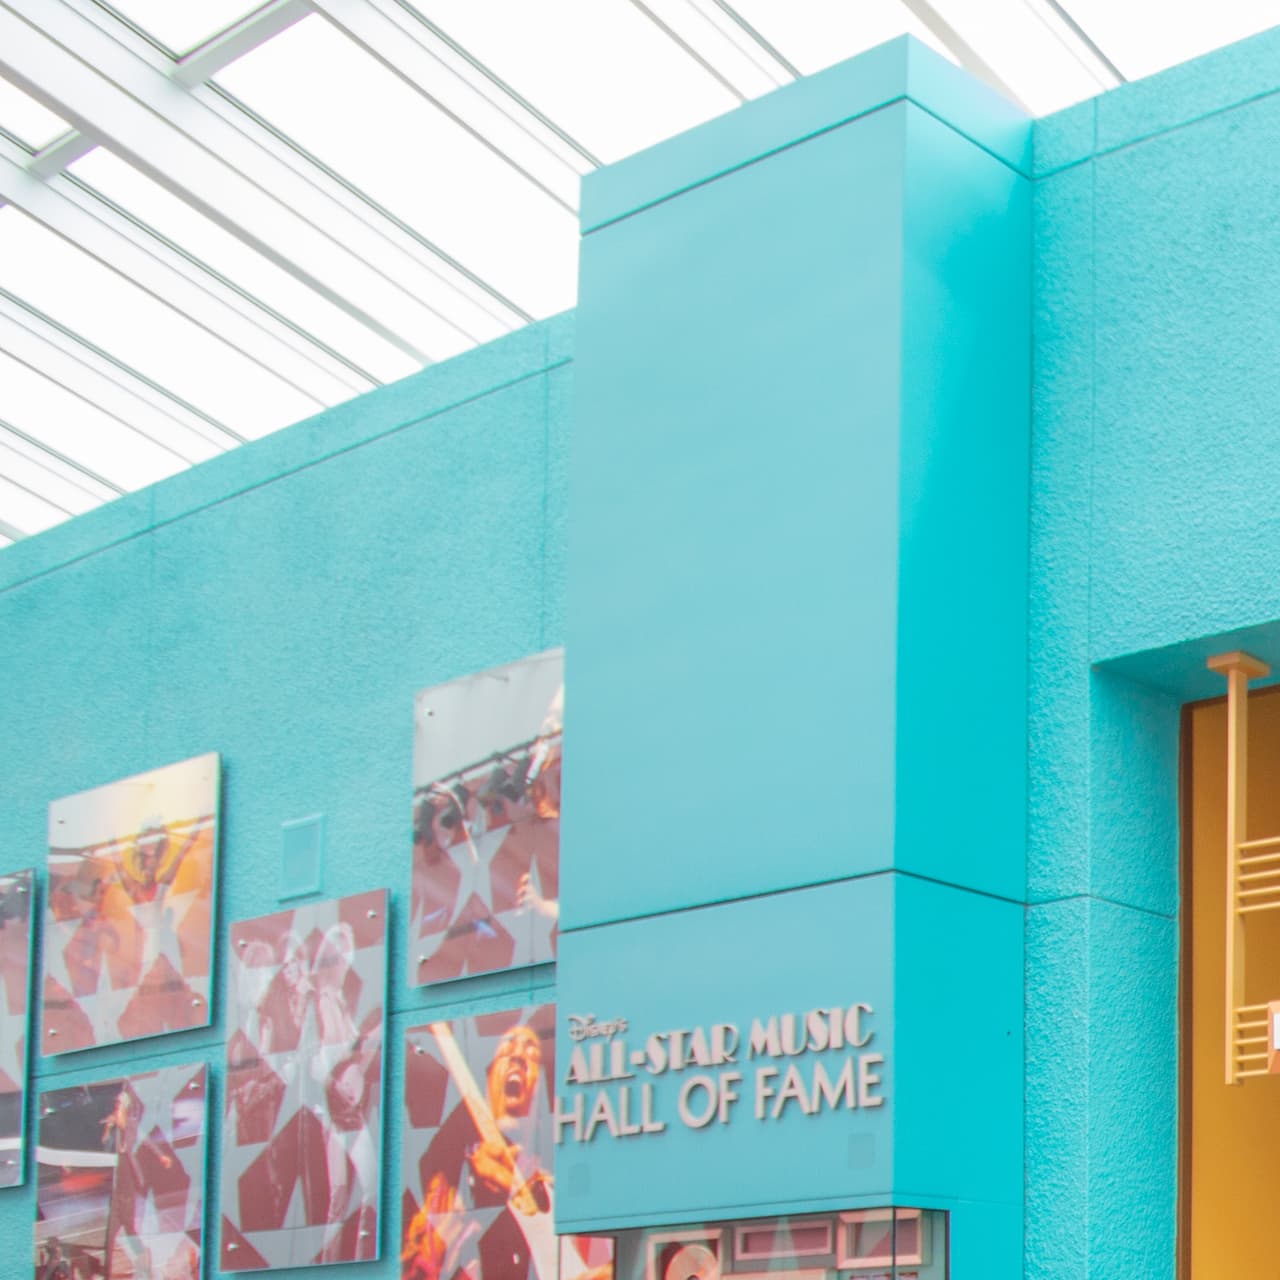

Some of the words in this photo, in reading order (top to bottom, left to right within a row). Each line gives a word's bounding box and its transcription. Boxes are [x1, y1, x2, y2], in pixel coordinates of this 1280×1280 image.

[749, 1004, 874, 1060] MUSIC
[554, 1083, 667, 1144] HALL
[678, 1072, 742, 1128] OF
[755, 1054, 885, 1120] FAME
